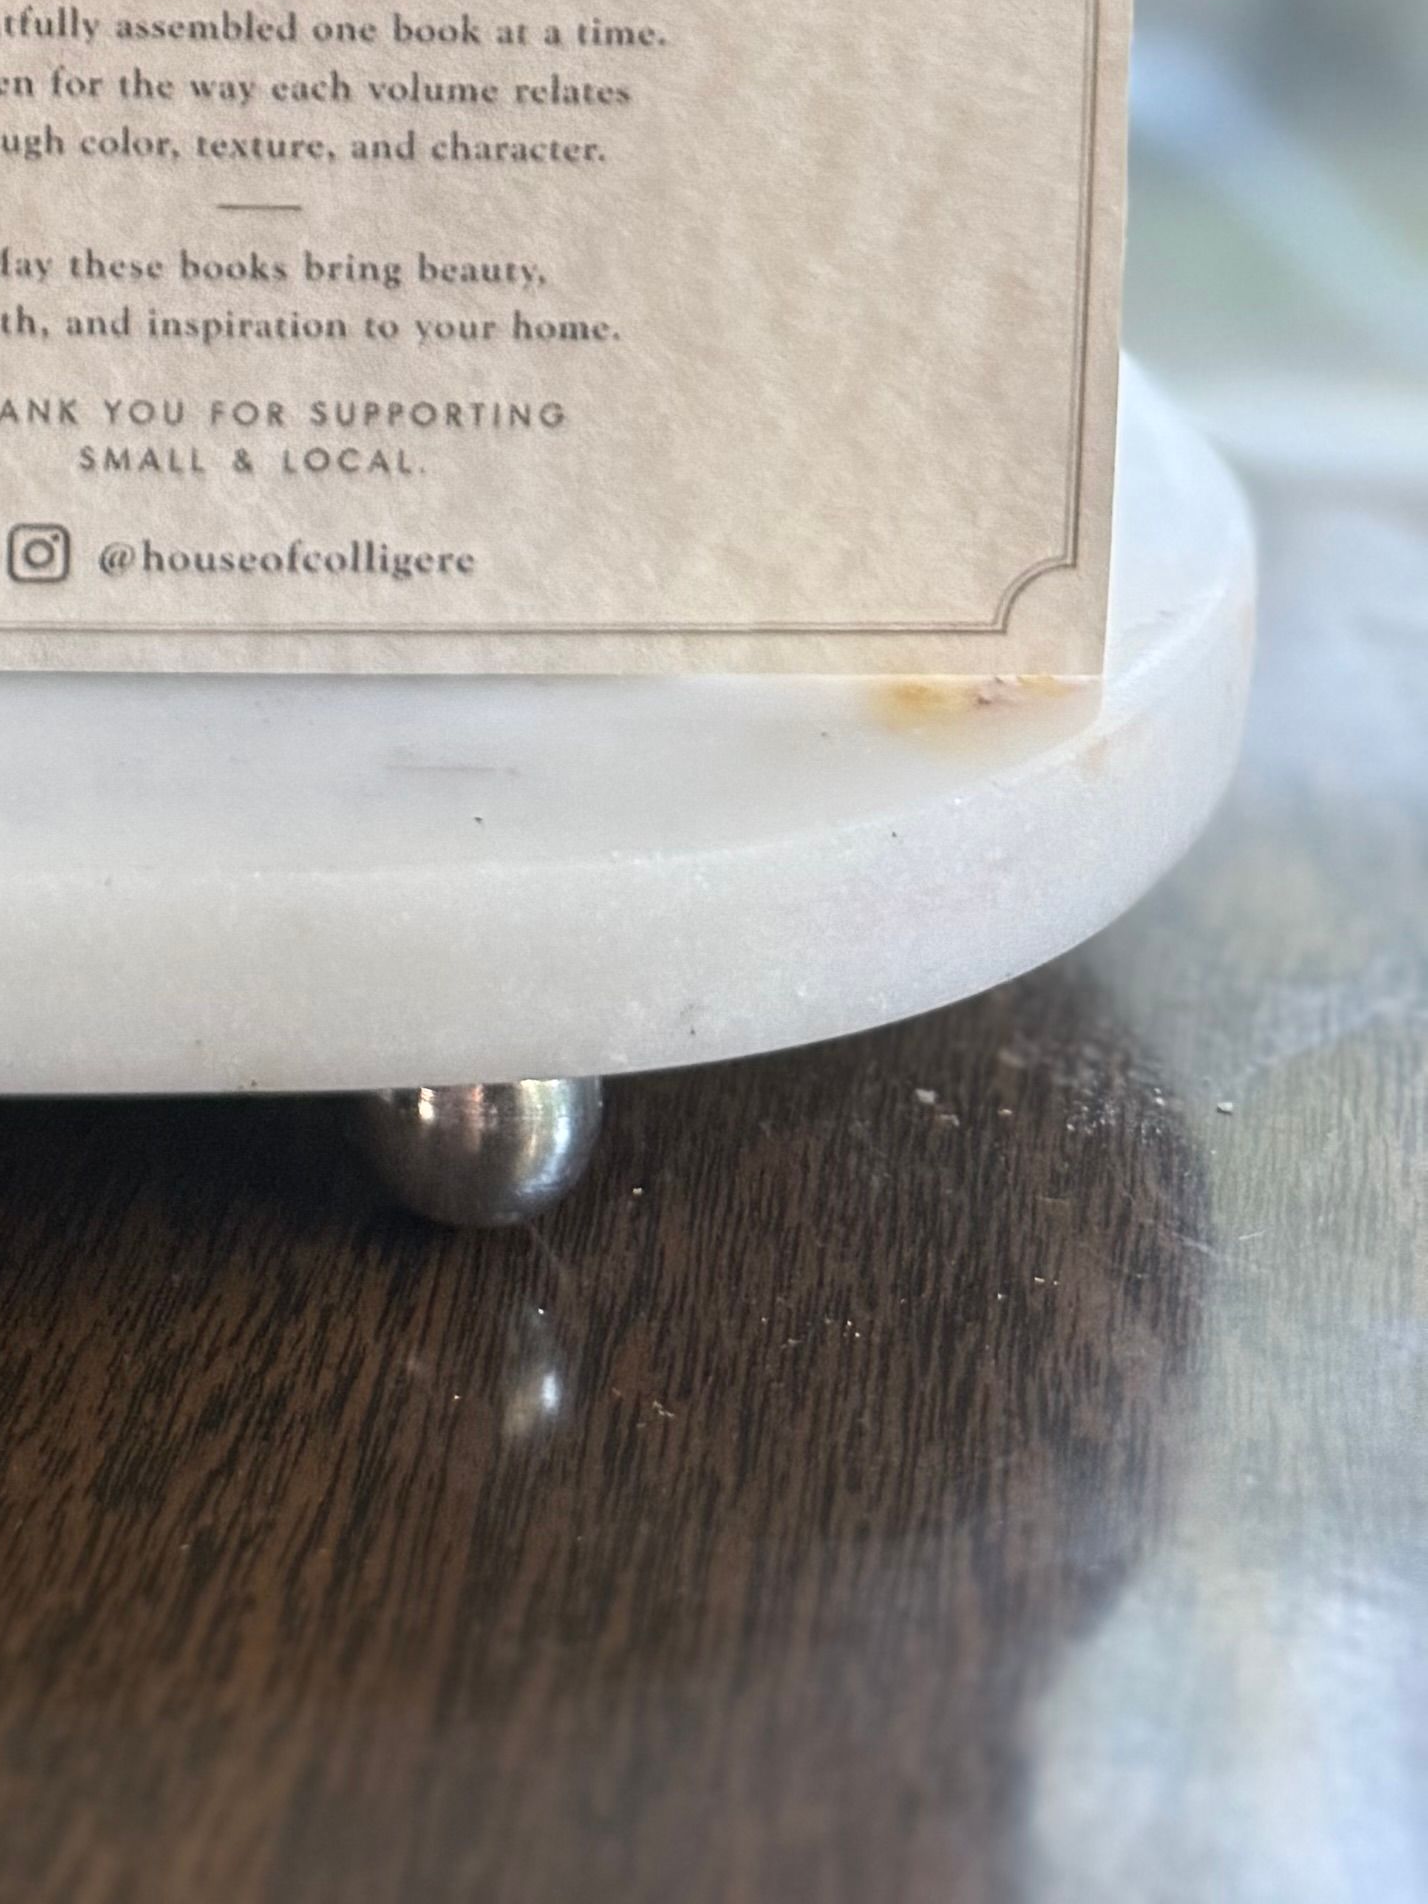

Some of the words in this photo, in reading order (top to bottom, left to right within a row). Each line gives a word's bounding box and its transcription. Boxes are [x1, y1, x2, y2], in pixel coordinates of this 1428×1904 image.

[115, 9, 297, 43] assembled
[311, 21, 378, 45] one
[393, 12, 482, 46] book
[496, 21, 528, 47] at
[544, 25, 562, 47] a
[576, 17, 669, 48] time.
[49, 65, 103, 99] for
[119, 66, 175, 100] the
[189, 77, 256, 106] way
[270, 70, 352, 105] each
[367, 71, 499, 106] volume
[514, 72, 632, 106] relates
[79, 125, 181, 162] color,
[196, 134, 337, 162] texture,
[350, 129, 416, 163] and
[430, 129, 607, 164] character.
[69, 248, 164, 281] these
[179, 248, 288, 283] books
[303, 249, 402, 290] bring
[417, 251, 548, 289] beauty,
[65, 305, 131, 338] and
[147, 308, 348, 344] inspiration
[364, 315, 400, 342] to
[414, 319, 497, 347] your
[512, 309, 621, 343] home.
[103, 398, 186, 427] YOU
[209, 399, 285, 428] FOR
[309, 400, 567, 429] SUPPORTING
[78, 444, 207, 474] SMALL
[231, 447, 255, 474] &
[98, 538, 477, 581] @houseofcolligere
